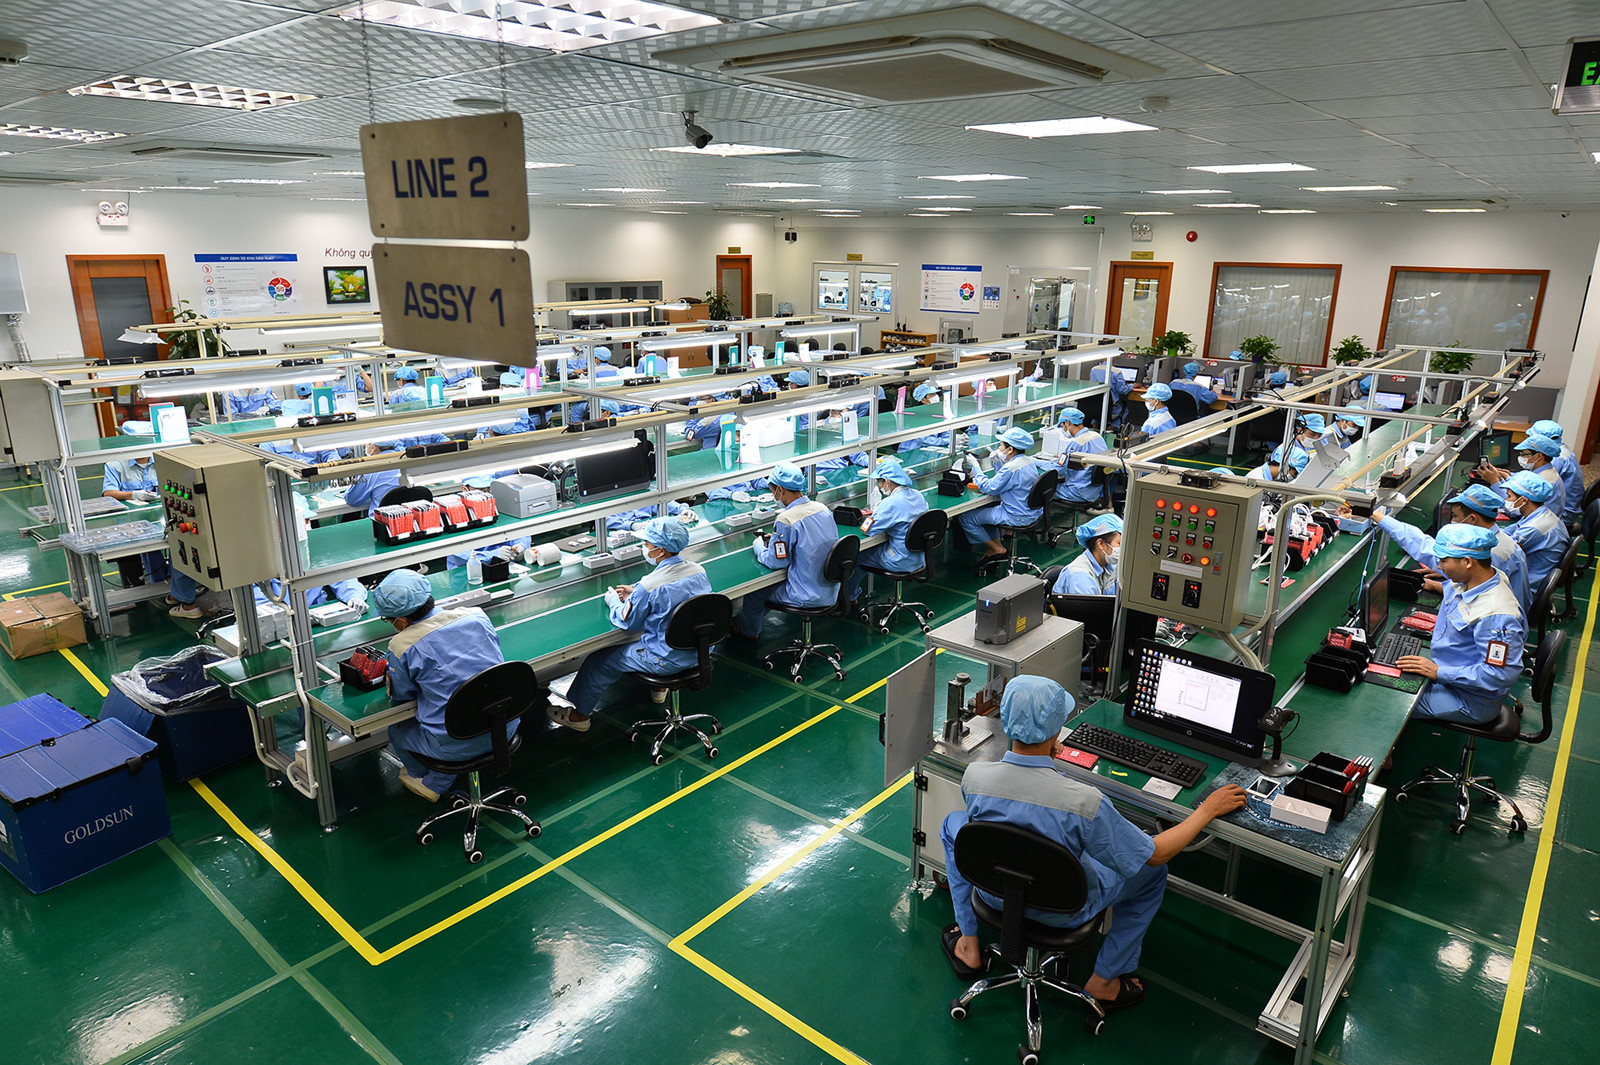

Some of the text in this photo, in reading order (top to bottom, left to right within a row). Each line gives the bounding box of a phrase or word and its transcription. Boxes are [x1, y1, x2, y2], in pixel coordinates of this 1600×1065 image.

[391, 155, 490, 198] LINE 2
[325, 247, 356, 260] Không
[404, 280, 505, 327] ASSY 1
[64, 804, 134, 844] GOLDSUN
